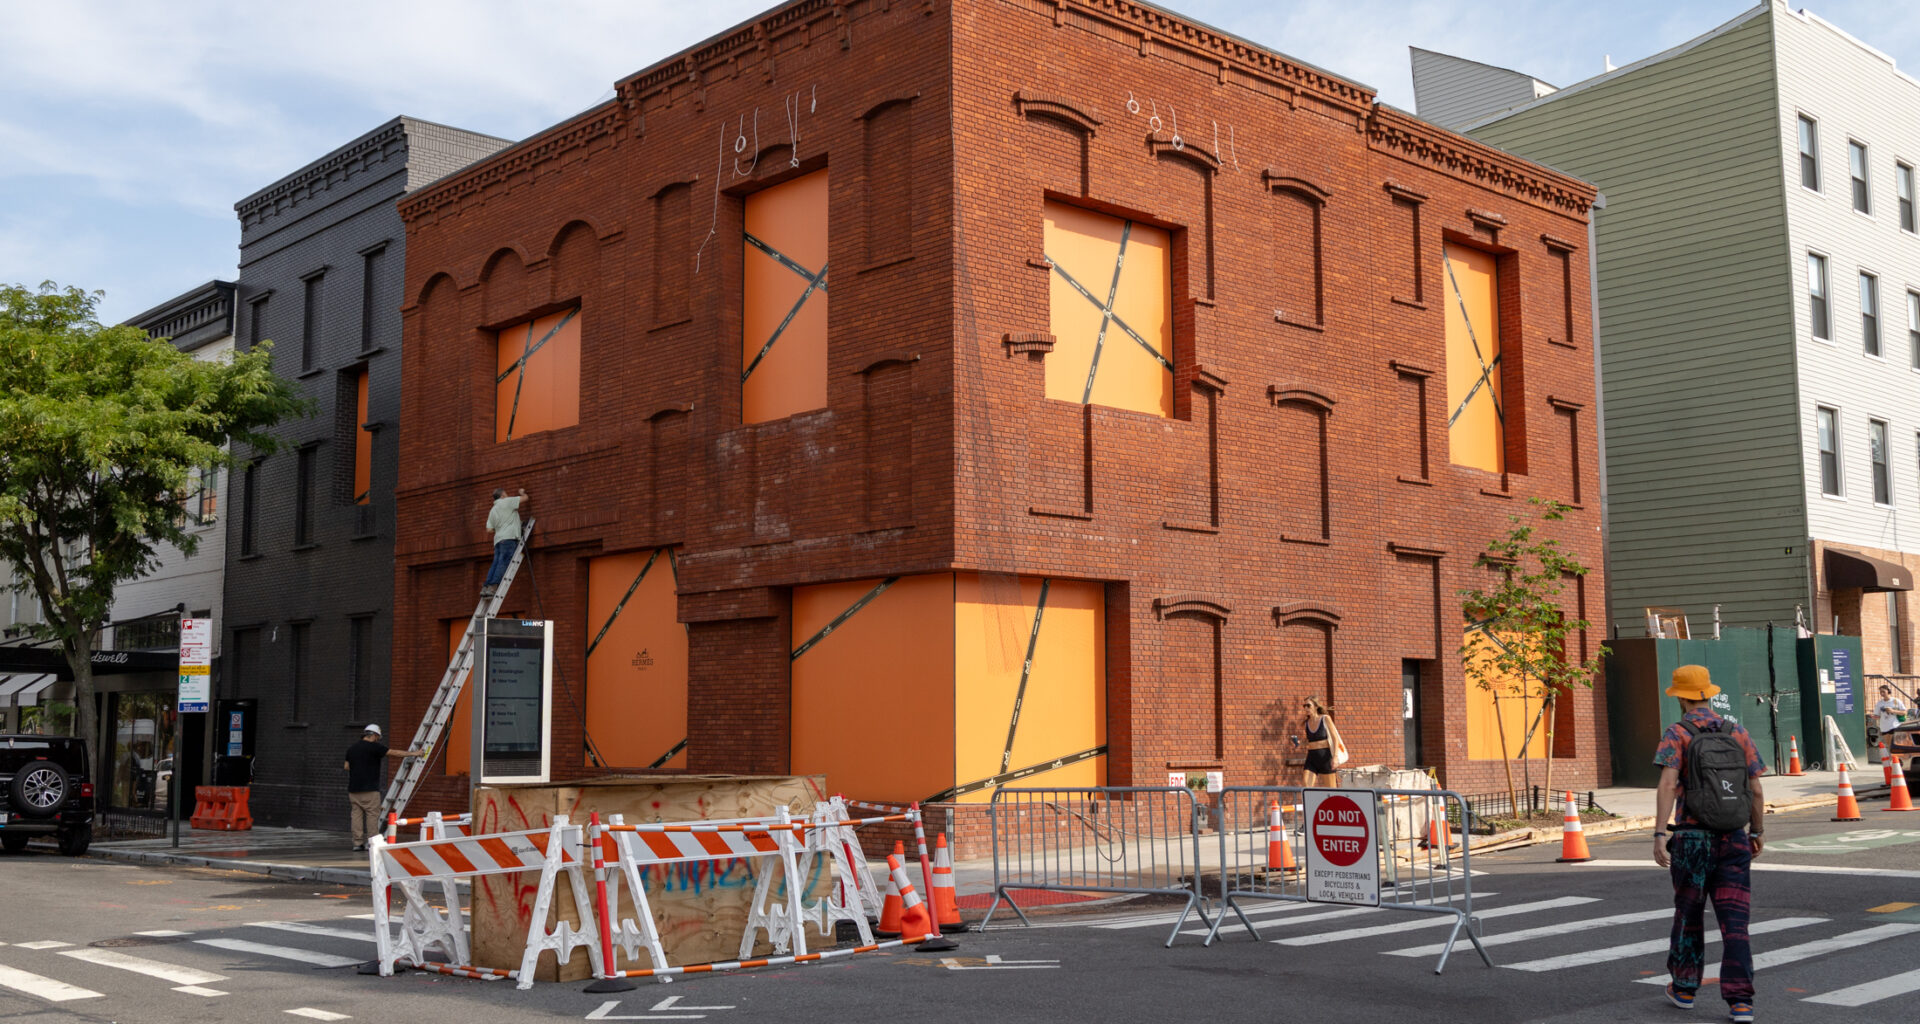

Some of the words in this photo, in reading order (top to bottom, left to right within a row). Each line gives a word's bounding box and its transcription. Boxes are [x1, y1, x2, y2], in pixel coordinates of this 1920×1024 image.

[521, 619, 543, 627] LinkNYC
[90, 651, 128, 664] dewell
[1318, 809, 1334, 822] DO
[1338, 810, 1360, 823] NOT
[1322, 839, 1360, 853] ENTER
[1314, 869, 1334, 878] EXCEPT
[1335, 871, 1371, 880] PEDESTRIANS
[1324, 880, 1354, 889] BICYCLISTS
[1319, 890, 1336, 899] LOCAL
[1338, 892, 1365, 900] VEHICLES
